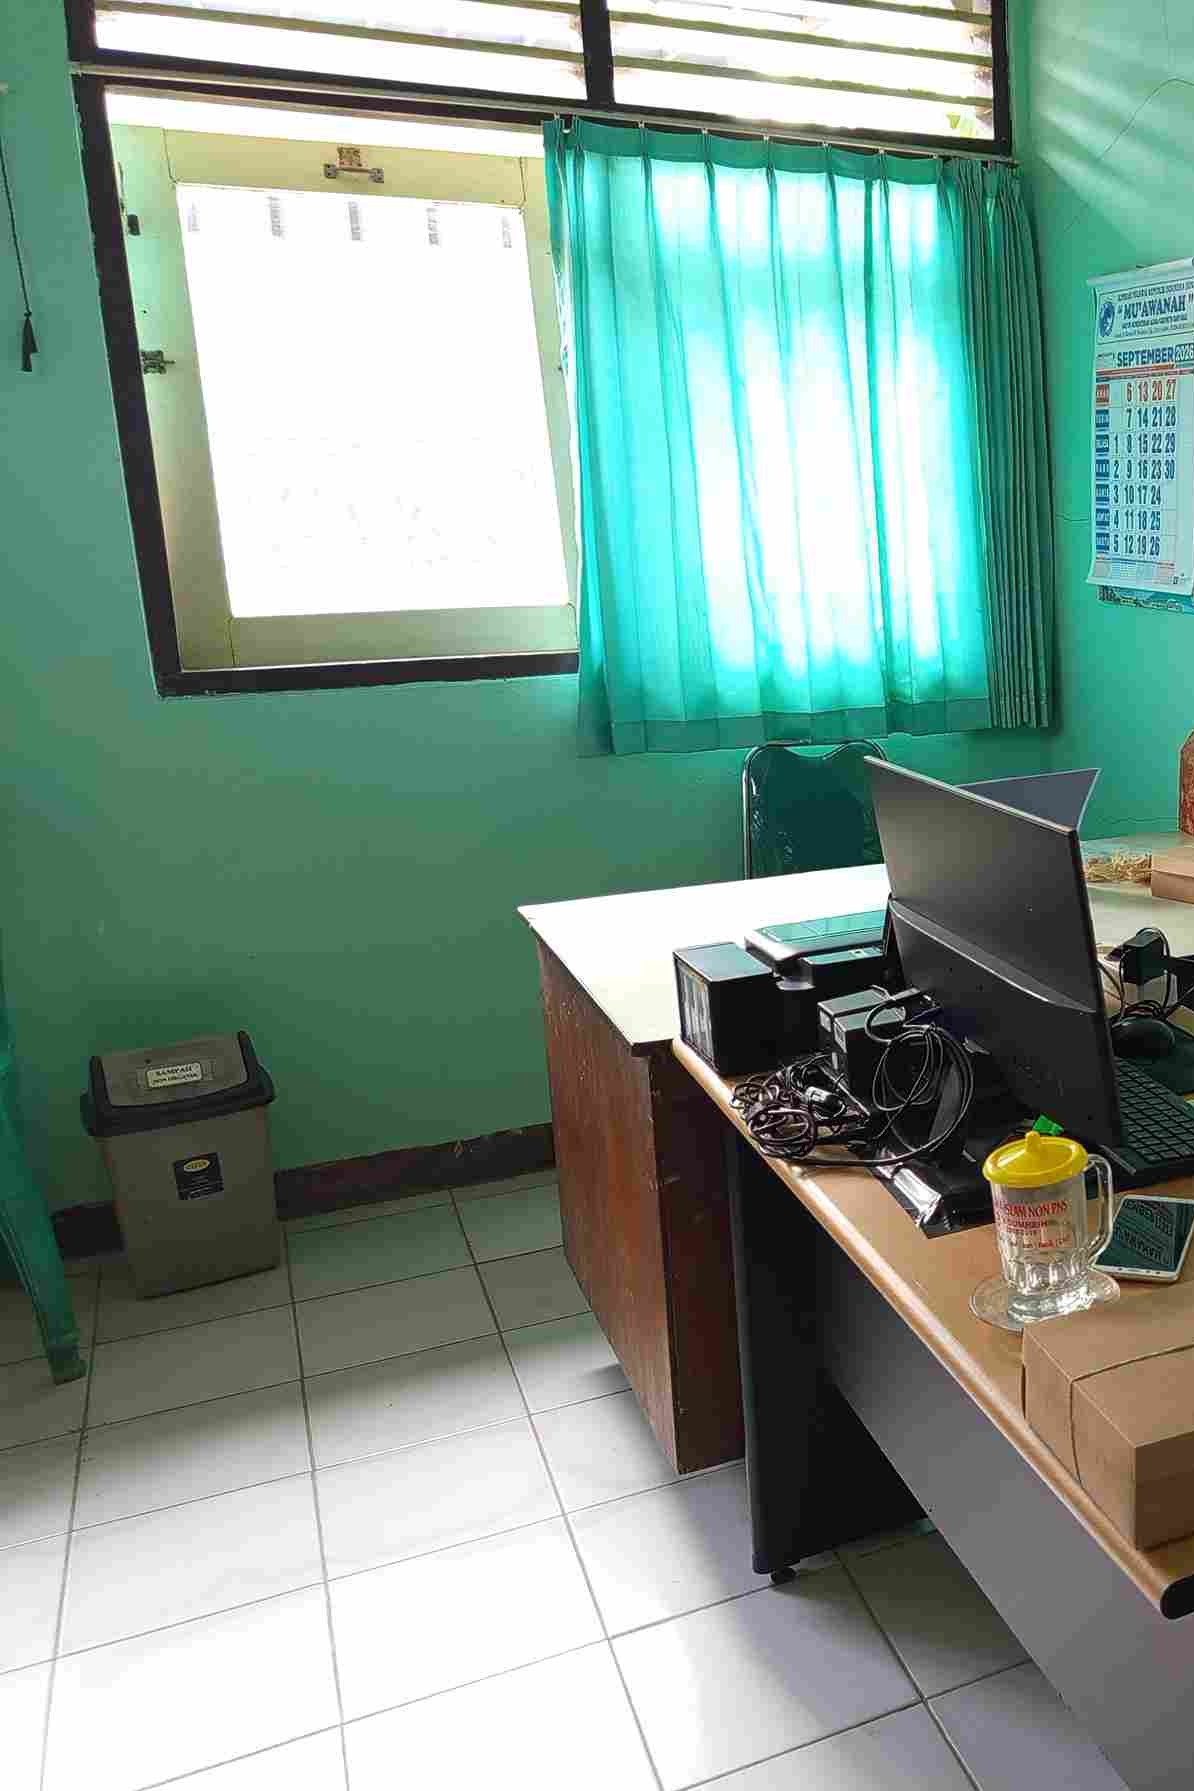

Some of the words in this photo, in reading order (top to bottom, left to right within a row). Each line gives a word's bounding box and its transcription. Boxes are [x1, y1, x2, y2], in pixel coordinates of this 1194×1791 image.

[1117, 346, 1174, 368] SEPTEMBER
[1126, 382, 1133, 402] 6
[1138, 381, 1149, 402] 13
[1152, 380, 1163, 401] 20
[1165, 378, 1176, 400] 27
[1126, 407, 1132, 428] 7
[1138, 407, 1148, 428] 14
[1152, 406, 1162, 427] 21
[1165, 406, 1176, 427] 28
[1138, 433, 1148, 453] 15
[1152, 433, 1162, 453] 22
[1113, 459, 1119, 479] 2
[1126, 459, 1132, 479] 9
[1138, 459, 1148, 480] 16
[1151, 459, 1162, 480] 23
[1165, 459, 1175, 480] 30
[1113, 484, 1119, 503] 3
[1125, 485, 1134, 504] 10
[1138, 485, 1148, 505] 17
[1151, 486, 1161, 505] 24
[1125, 510, 1134, 529] 11
[1138, 510, 1147, 530] 18
[1151, 511, 1161, 530] 25
[1113, 534, 1119, 553] 5
[1125, 535, 1134, 554] 12
[1138, 535, 1147, 555] 19
[1150, 536, 1160, 556] 26
